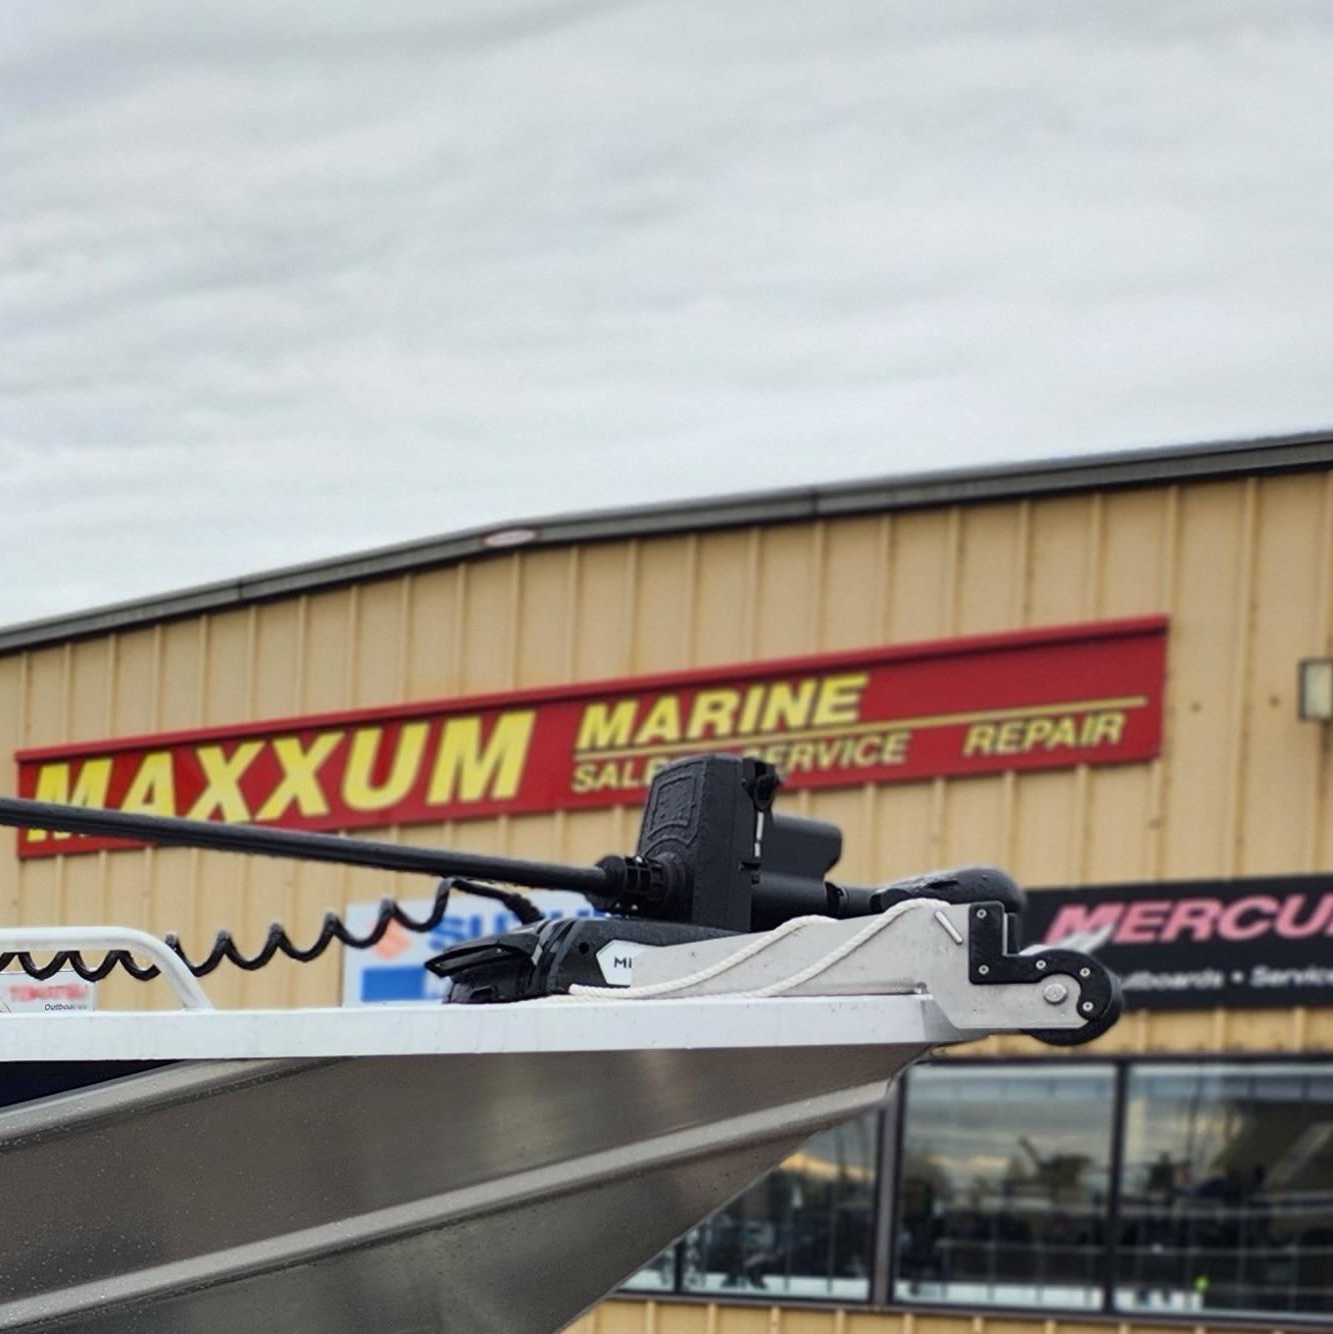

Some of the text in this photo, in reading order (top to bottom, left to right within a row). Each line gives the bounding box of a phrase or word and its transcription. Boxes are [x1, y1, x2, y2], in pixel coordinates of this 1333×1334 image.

[575, 674, 869, 749] MARINE
[26, 709, 537, 843] MAXXUM
[571, 757, 664, 793] SALE
[962, 711, 1126, 757] REPAIR
[1043, 894, 1333, 947] MERCU
[613, 956, 633, 969] MI
